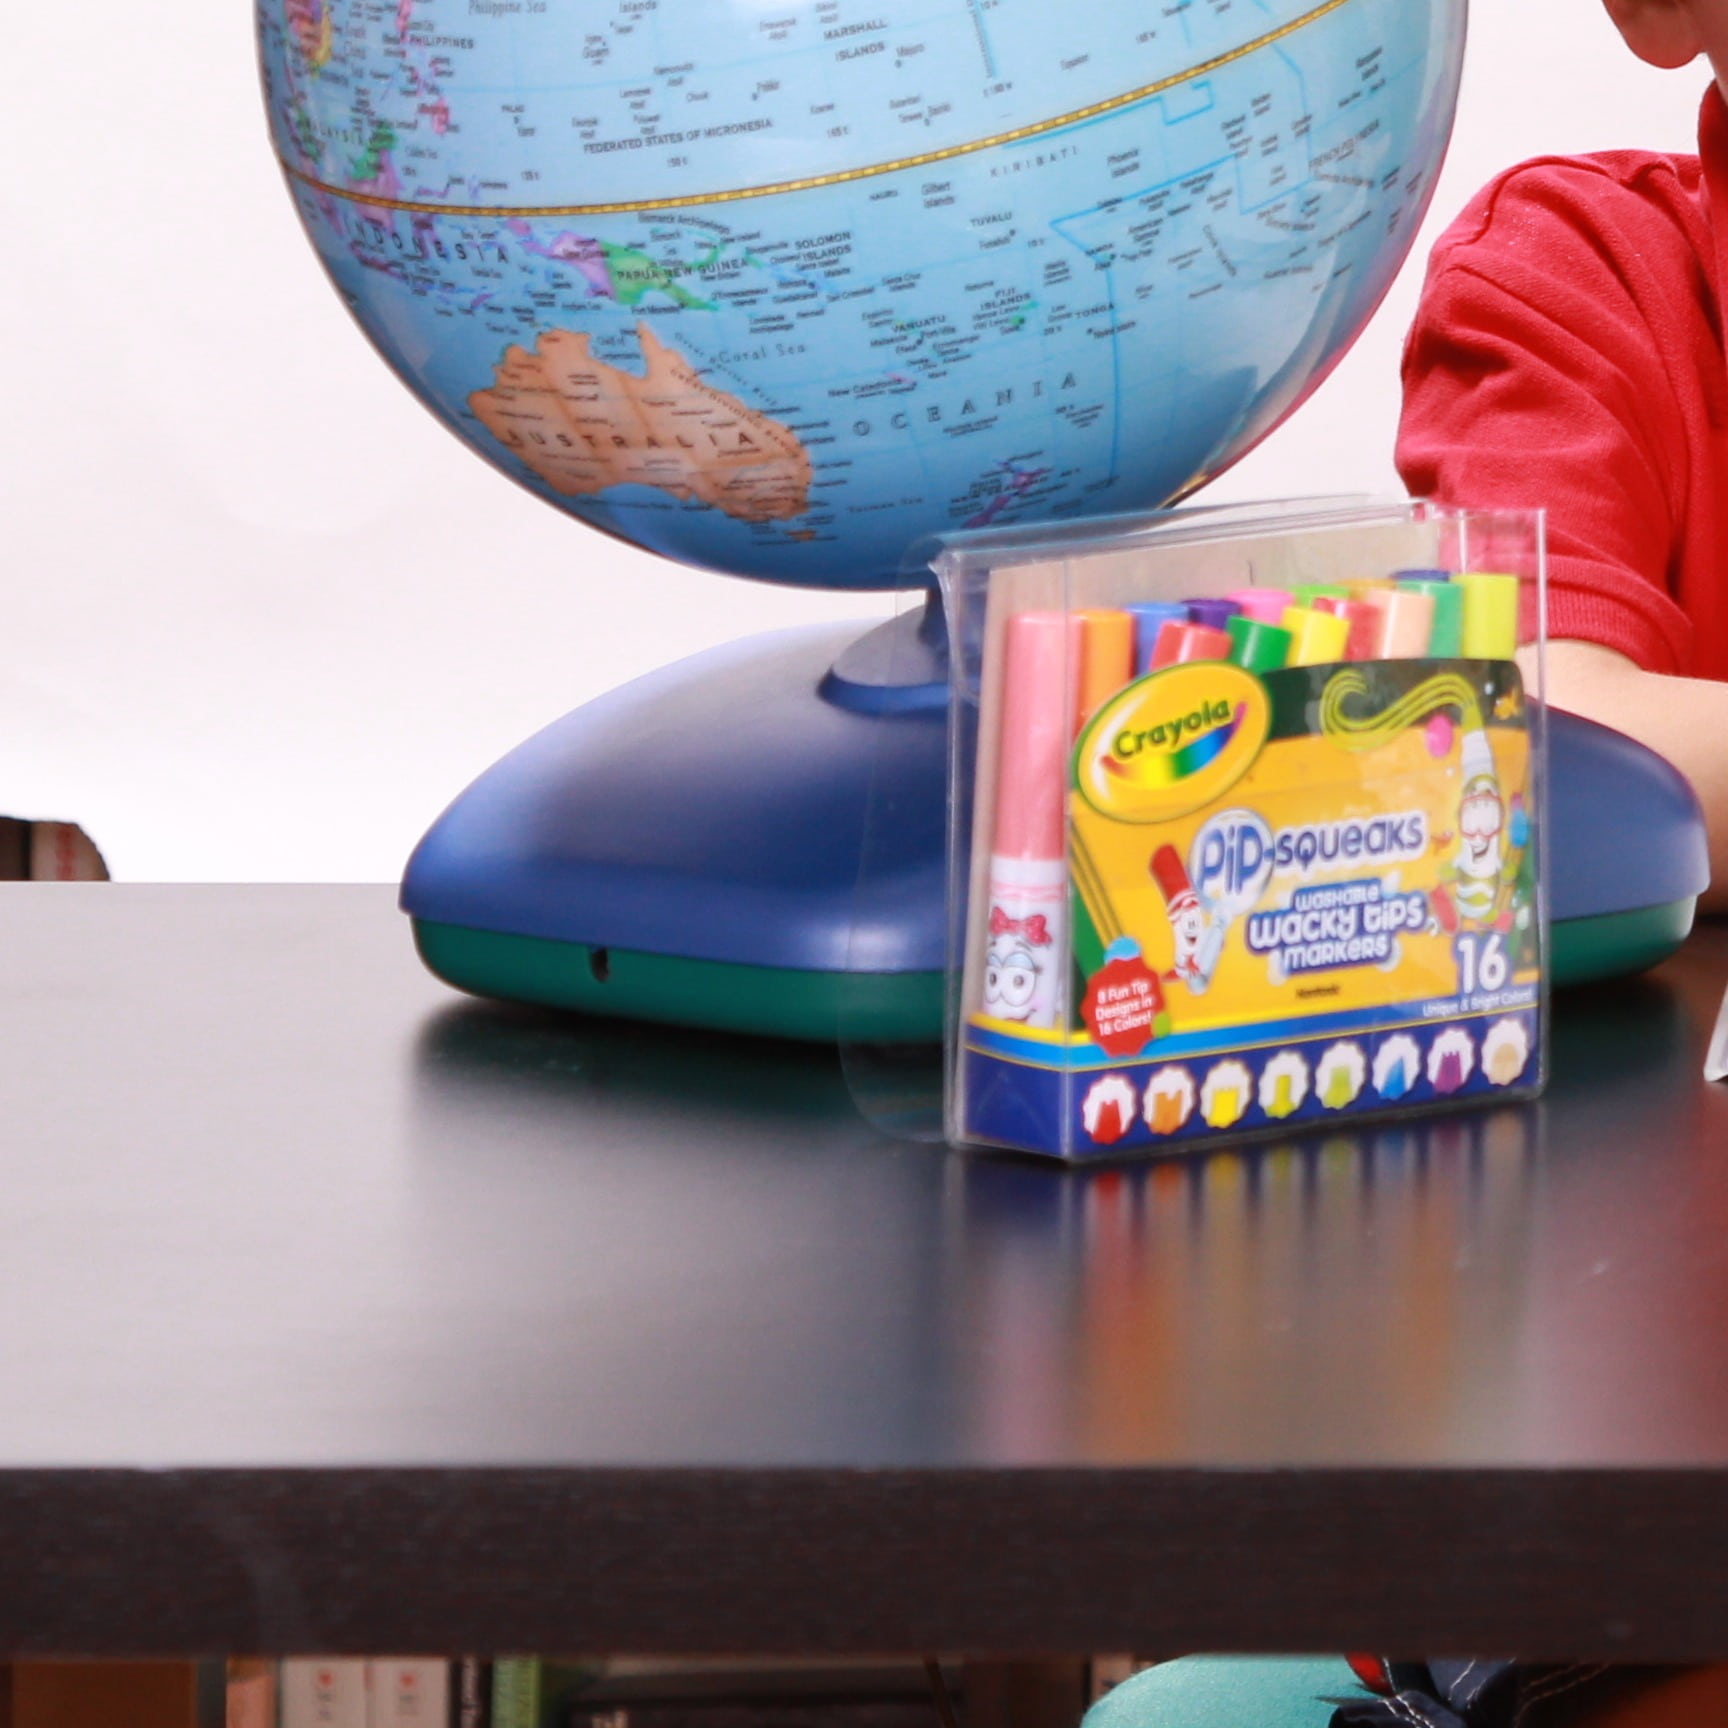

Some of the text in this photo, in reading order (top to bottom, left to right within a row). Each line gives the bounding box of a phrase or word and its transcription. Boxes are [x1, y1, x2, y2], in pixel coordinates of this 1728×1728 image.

[618, 0, 658, 13] Islands
[822, 17, 889, 42] MARSHALL
[834, 40, 888, 62] ISLANDS
[583, 118, 773, 154] FEDERATED STATES OF MICRONESIA
[969, 211, 1013, 227] TUVALU
[794, 230, 852, 250] SOLOMON
[802, 243, 853, 262] ISLANDS
[616, 257, 751, 282] PAPUA NEW GUINEA
[979, 292, 1032, 312] ISLANDS
[1073, 302, 1115, 320] TONGA
[890, 314, 946, 335] VANUATU
[775, 342, 807, 358] Sea
[852, 371, 1079, 439] OCEANIA
[506, 426, 754, 452] AUSTRALIA
[1112, 698, 1233, 760] Crayola
[1457, 932, 1508, 994] 16
[1107, 985, 1130, 1003] Fun
[1130, 979, 1150, 998] Tip
[1094, 1000, 1141, 1023] Designs
[1112, 1009, 1153, 1033] Colors!
